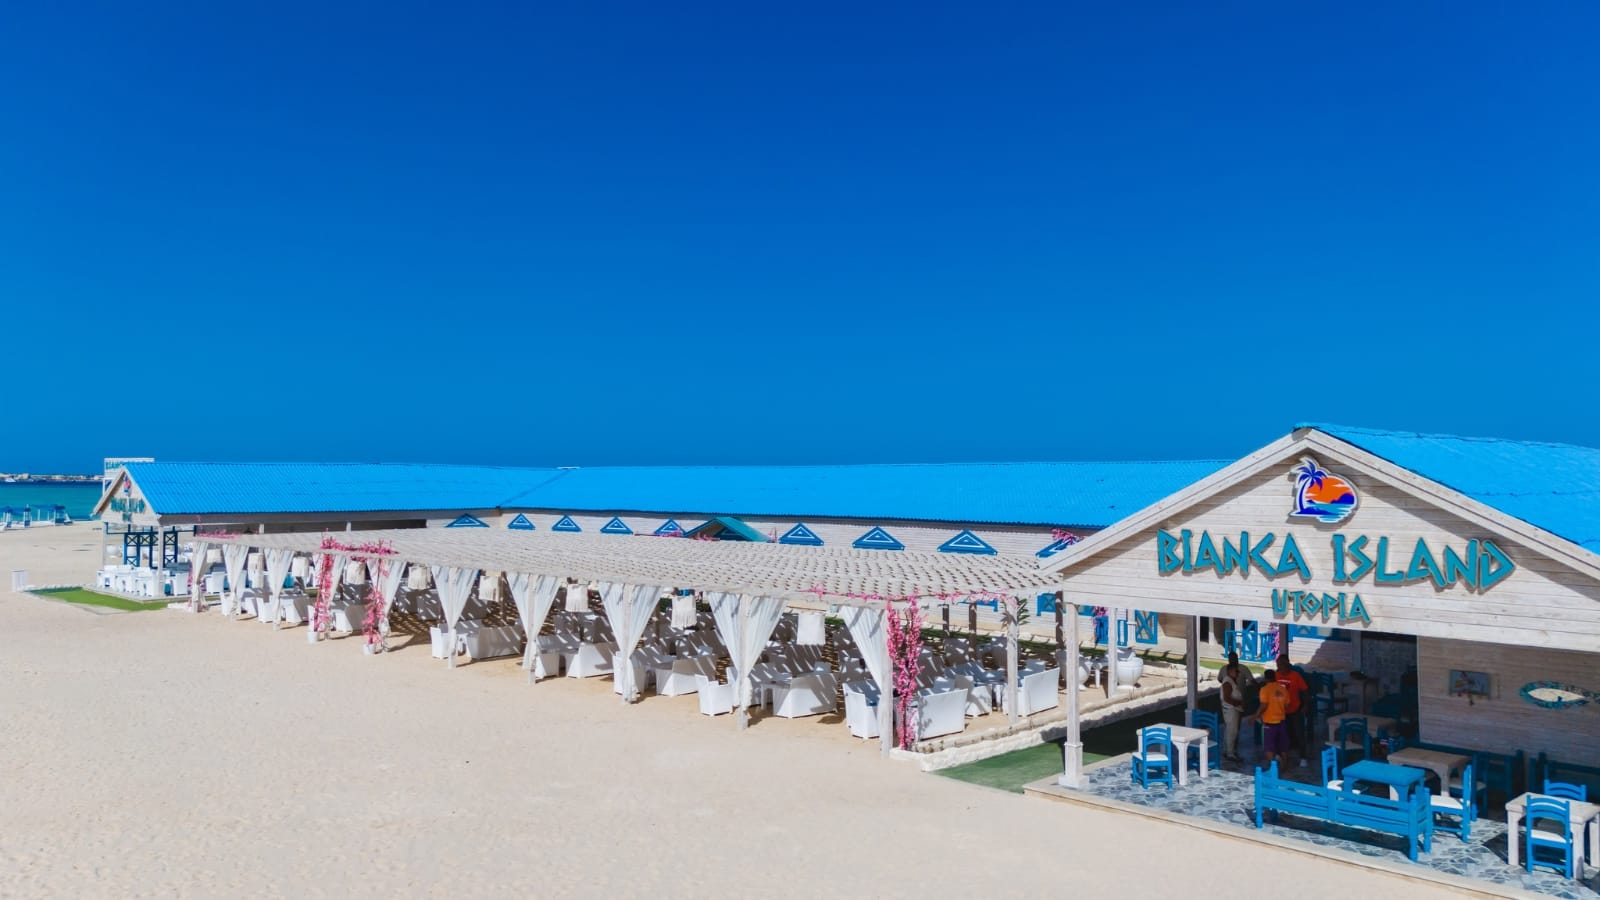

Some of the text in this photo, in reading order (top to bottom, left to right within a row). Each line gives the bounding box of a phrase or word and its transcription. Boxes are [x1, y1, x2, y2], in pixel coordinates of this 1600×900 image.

[1157, 528, 1515, 590] BIANCA ISLAND
[1271, 588, 1371, 624] UTOPIA
